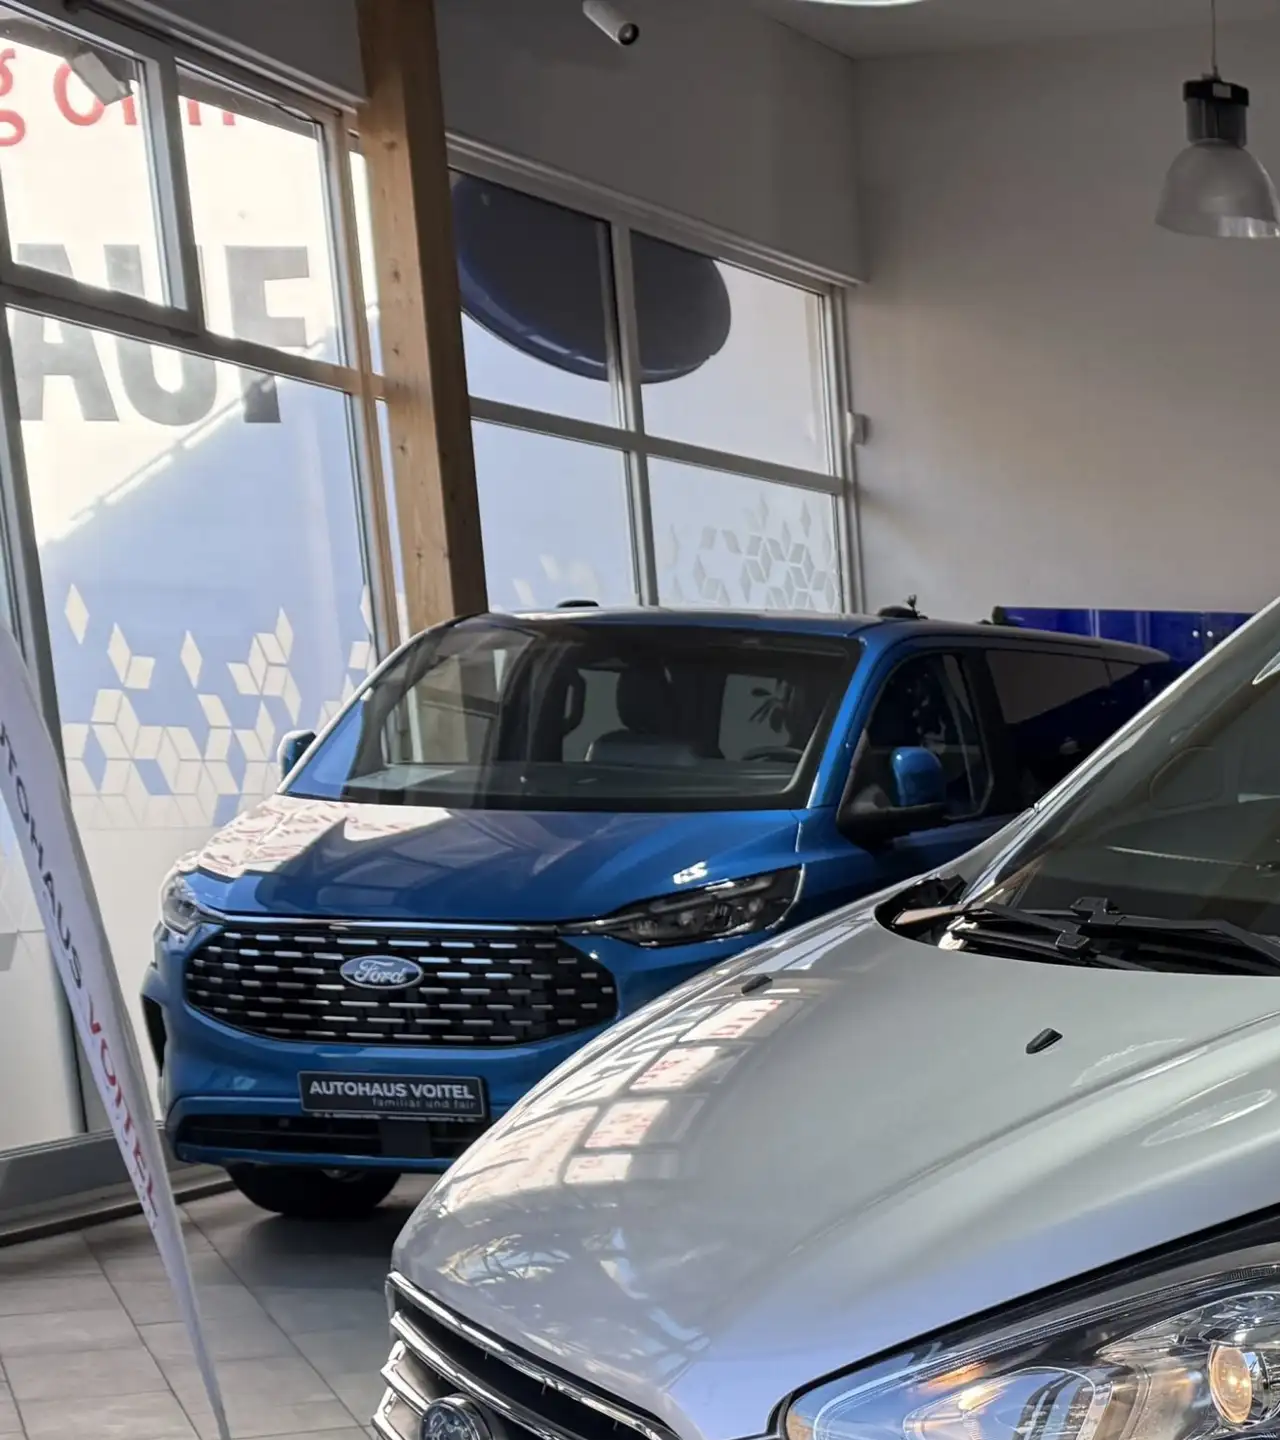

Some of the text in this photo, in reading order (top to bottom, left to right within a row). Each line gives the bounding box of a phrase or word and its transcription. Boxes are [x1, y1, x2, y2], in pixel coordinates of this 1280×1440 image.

[354, 960, 407, 984] Ford
[309, 1080, 475, 1099] AUTOHAUS VOITEL
